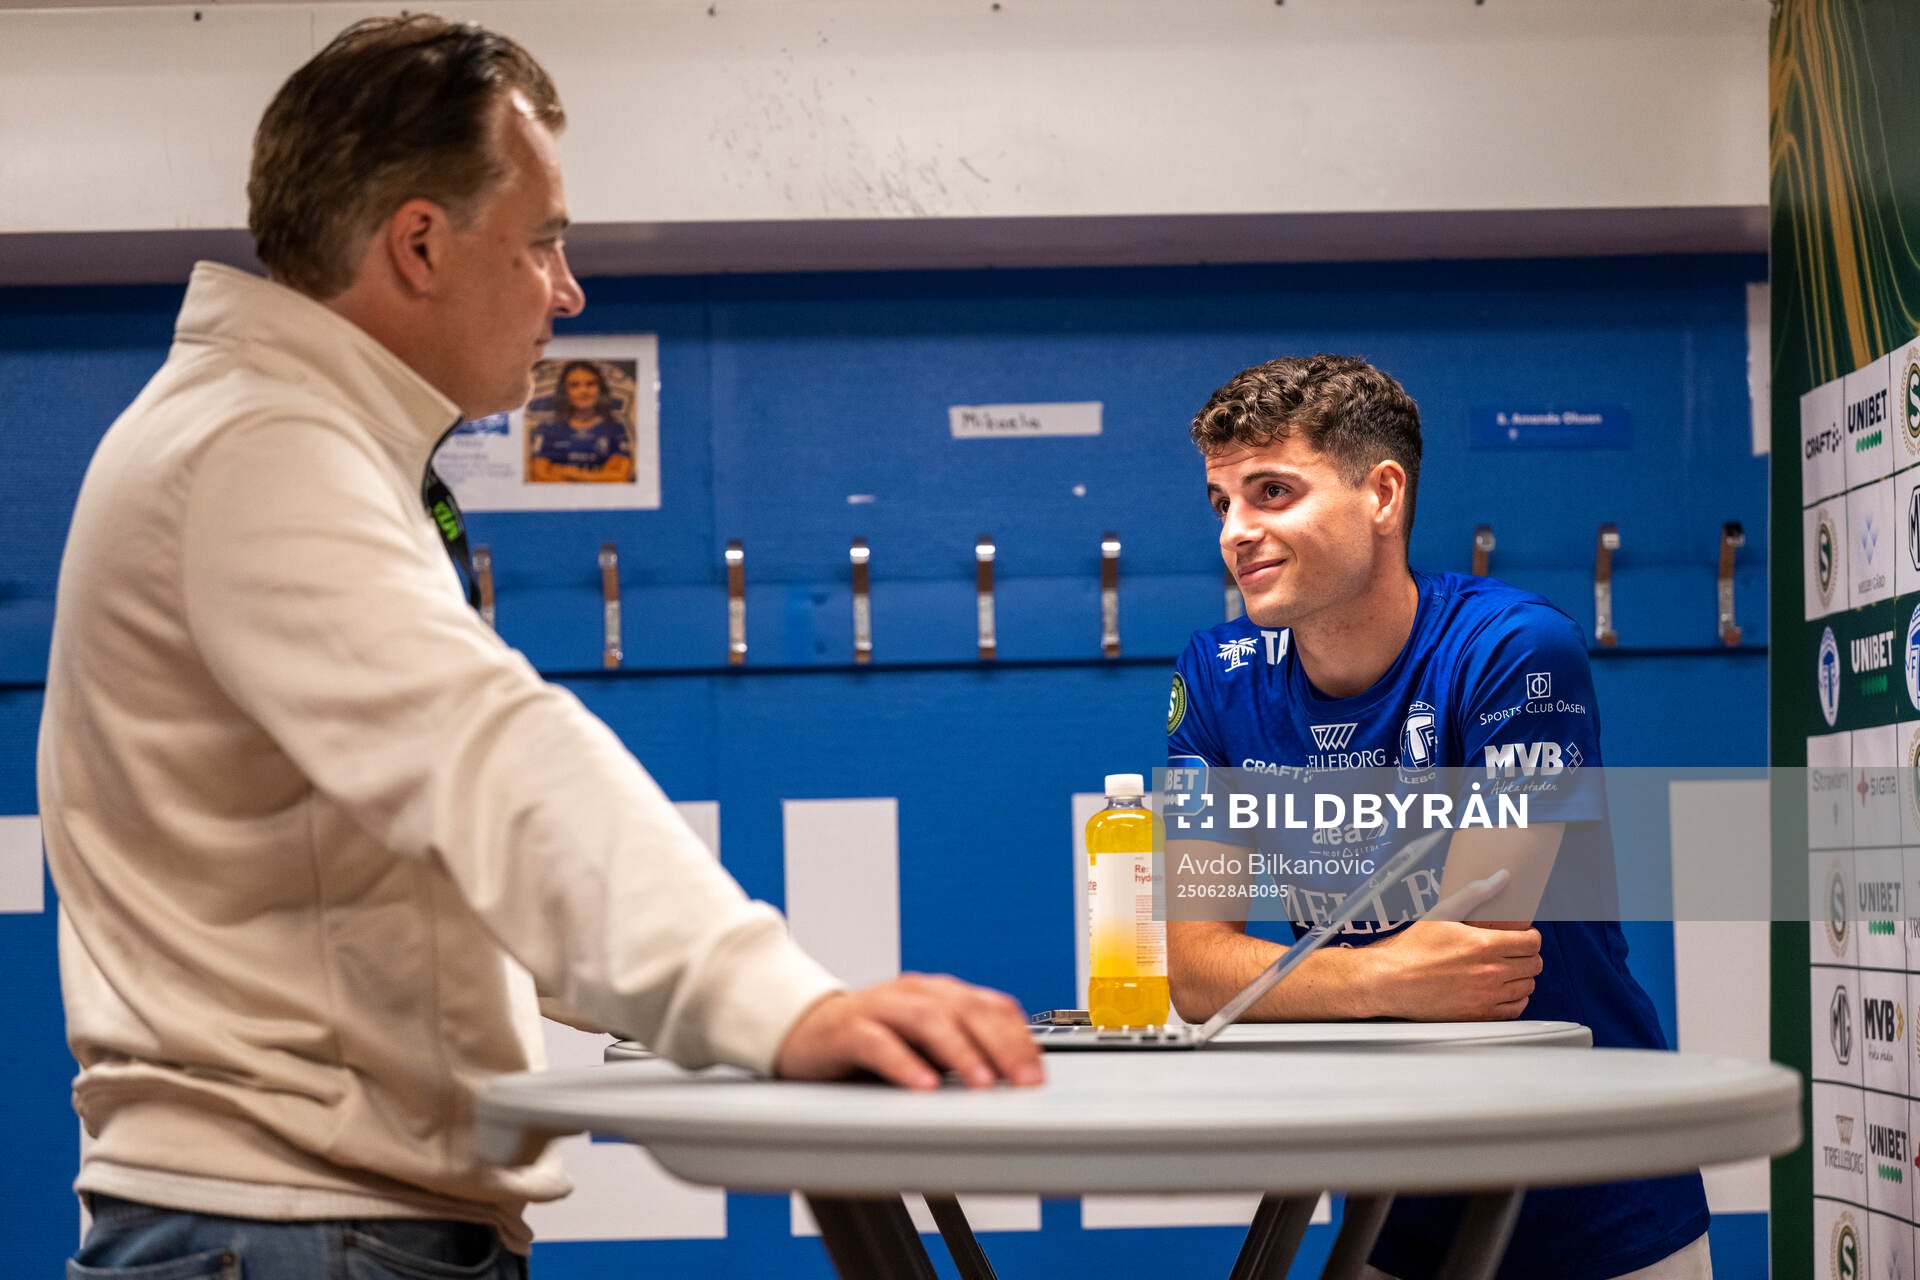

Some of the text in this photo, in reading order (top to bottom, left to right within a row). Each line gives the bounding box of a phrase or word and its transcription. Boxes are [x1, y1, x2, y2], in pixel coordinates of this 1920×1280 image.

[1848, 389, 1888, 434] UNIBET
[1805, 430, 1832, 460] CRAFT
[1851, 631, 1894, 674] UNIBET
[1242, 758, 1304, 781] CRAFT
[1308, 748, 1387, 773] ELLEBORG
[1484, 741, 1564, 780] MVB
[1165, 768, 1200, 791] BET
[1858, 882, 1901, 913] UNIBET
[1864, 997, 1895, 1042] MVB
[1869, 1123, 1907, 1163] UNIBET
